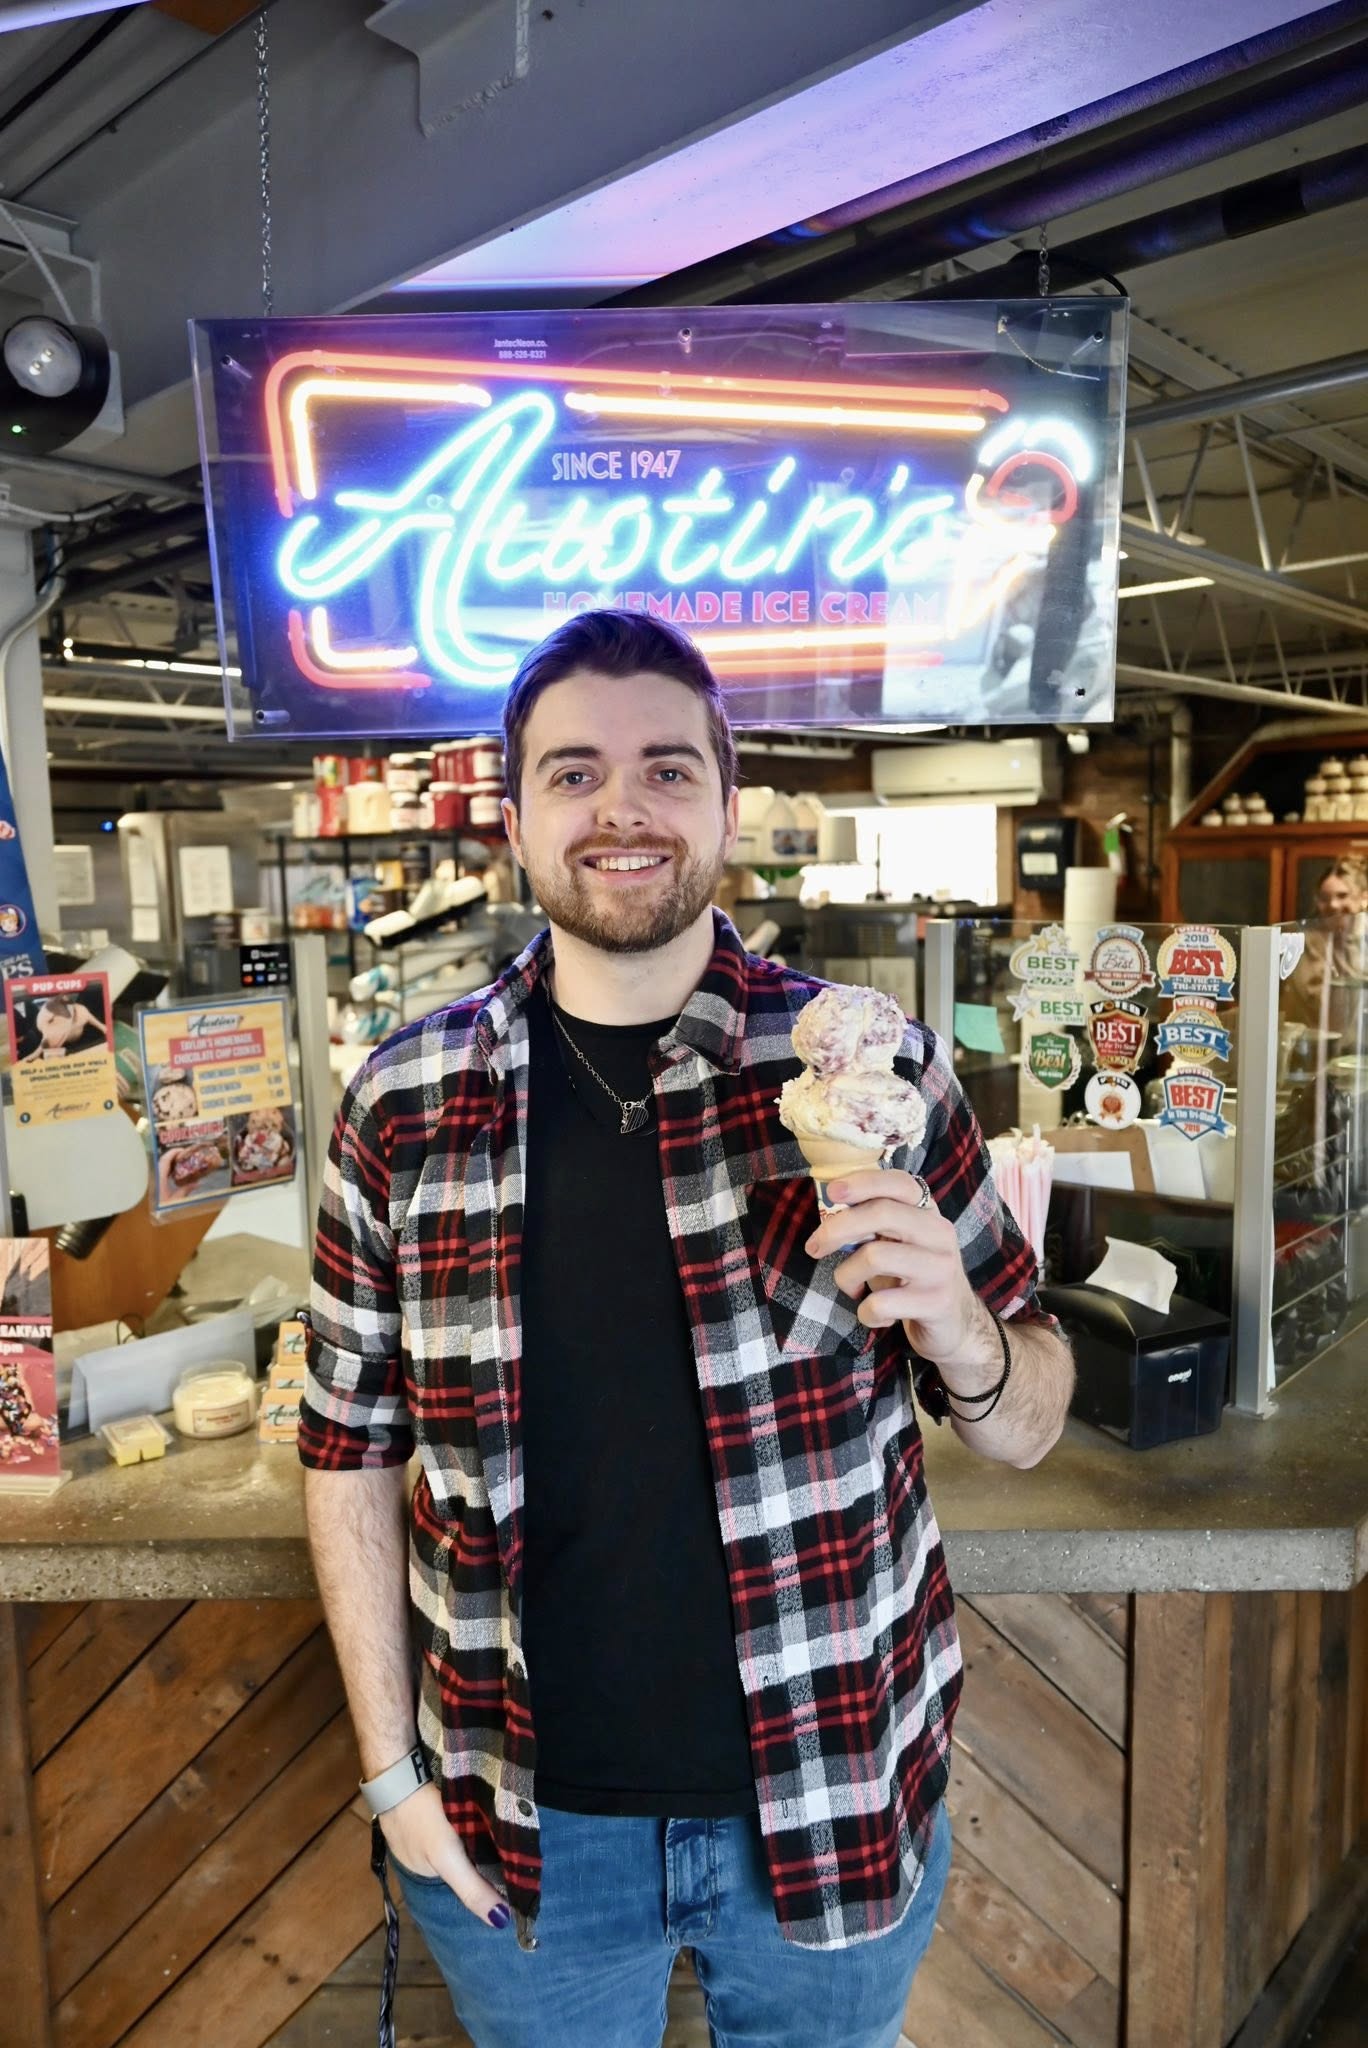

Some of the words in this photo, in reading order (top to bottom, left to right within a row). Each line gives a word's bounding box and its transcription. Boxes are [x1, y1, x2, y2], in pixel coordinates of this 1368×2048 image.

[551, 451, 622, 481] SINCE
[630, 449, 682, 479] 1947
[542, 590, 742, 624] HOMEMADE
[751, 591, 810, 623] ICE
[819, 592, 942, 625] CREAM
[1184, 934, 1209, 943] 2018
[1027, 956, 1080, 971] BEST
[1167, 948, 1225, 978] BEST
[32, 982, 54, 992] PUP
[56, 980, 82, 990] CUPS
[1029, 977, 1075, 987] 2022
[1173, 982, 1220, 992] TRI-STATE
[1041, 1000, 1084, 1016] BEST
[1096, 1021, 1141, 1044] BEST
[1165, 1026, 1224, 1046] BEST
[1033, 1048, 1067, 1069] Best
[1171, 1084, 1218, 1110] BEST
